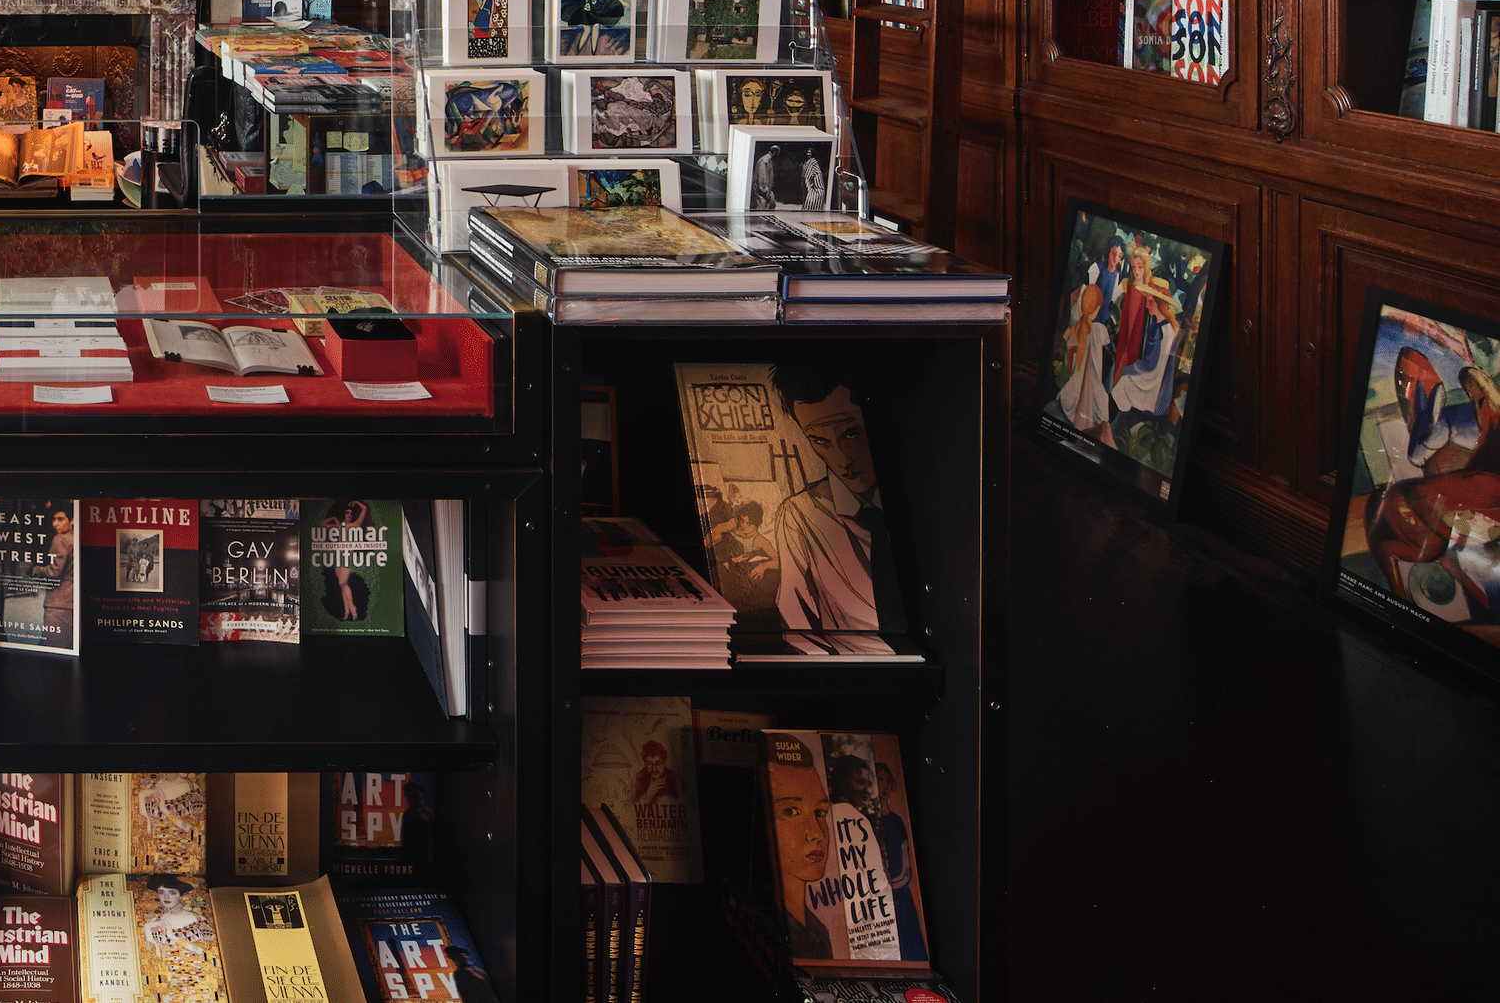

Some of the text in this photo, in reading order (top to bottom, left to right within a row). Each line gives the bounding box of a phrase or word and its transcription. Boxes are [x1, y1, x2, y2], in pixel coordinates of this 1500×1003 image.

[1431, 40, 1439, 70] Kandinsky's
[88, 506, 190, 526] RATLINE
[311, 521, 388, 542] weimar
[226, 540, 276, 560] GAY
[311, 549, 388, 568] culture
[212, 567, 288, 586] BERLIN
[29, 623, 62, 634] SANDS
[97, 618, 184, 629] PHILIPPE SANDS
[775, 741, 800, 752] SUSAN
[776, 752, 802, 762] WIDER
[1, 773, 34, 792] The
[89, 773, 123, 783] INSIGHT
[340, 772, 406, 807] ART
[633, 804, 687, 819] WALTER
[340, 810, 404, 842] SPY
[636, 818, 688, 830] BENJAMIN
[836, 818, 869, 844] IT'S
[238, 834, 285, 850] VIENNA
[637, 829, 688, 843] REIMAGINED
[92, 858, 120, 869] KANDEL
[839, 844, 867, 871] MY
[333, 863, 414, 875] MICHELLE YOUNG
[807, 868, 881, 910] WHOLE
[2, 906, 41, 925] The
[92, 910, 127, 918] INSIGHT
[850, 894, 891, 925] LIFE
[389, 923, 422, 935] THE
[609, 929, 620, 959] WOMAN
[633, 926, 645, 956] WOMAN
[378, 940, 450, 969] ART
[2, 975, 26, 983] Social
[27, 975, 55, 984] History
[7, 968, 49, 976] Intellectual
[99, 979, 130, 987] KANDEL
[268, 985, 324, 999] VIENNA
[384, 972, 460, 1000] SPY
